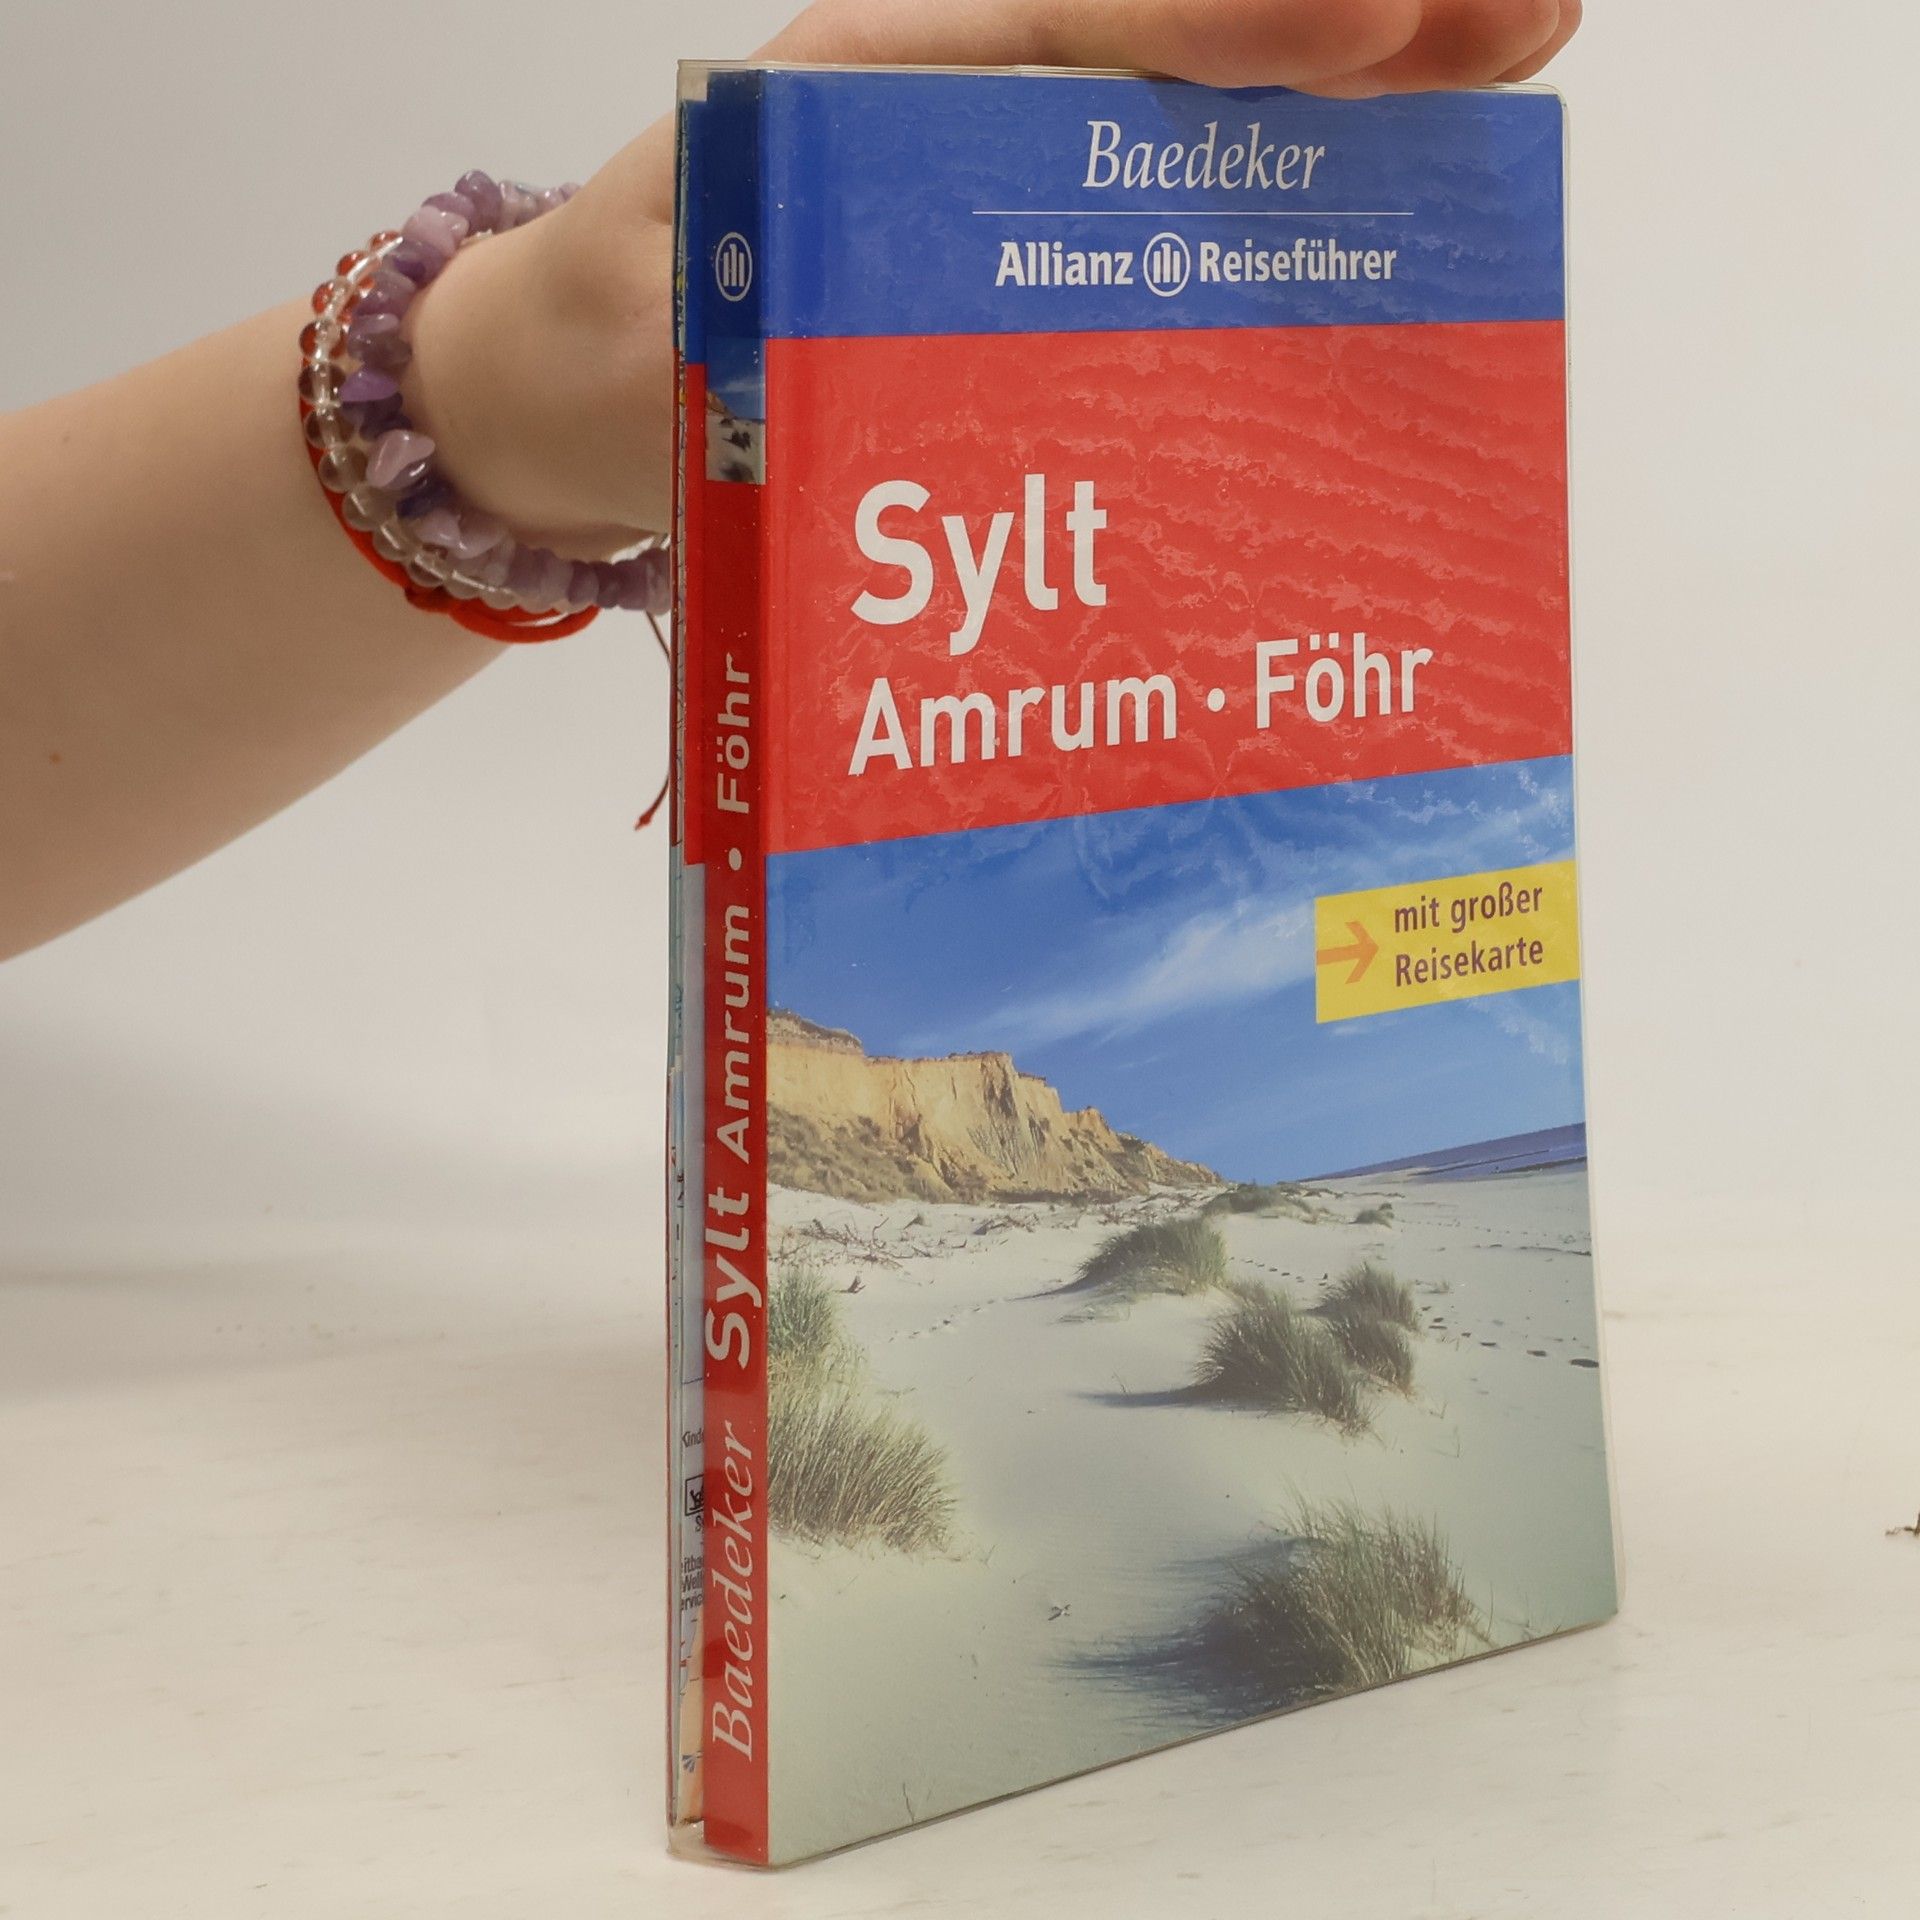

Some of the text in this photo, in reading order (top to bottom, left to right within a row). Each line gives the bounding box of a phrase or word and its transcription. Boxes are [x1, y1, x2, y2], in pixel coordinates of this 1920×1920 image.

[1082, 120, 1327, 190] Baedeker
[994, 237, 1398, 287] Allianz Reiseführer
[849, 472, 1108, 657] Sylt
[716, 651, 751, 815] Föhr
[847, 674, 1178, 777] Amrum
[1255, 631, 1434, 730] Föhr
[1394, 880, 1543, 934] mit großer
[1395, 936, 1544, 987] Reisekarte
[716, 903, 751, 1165] Amrum
[704, 1185, 763, 1370] Sylt
[711, 1418, 754, 1764] Baedeker
